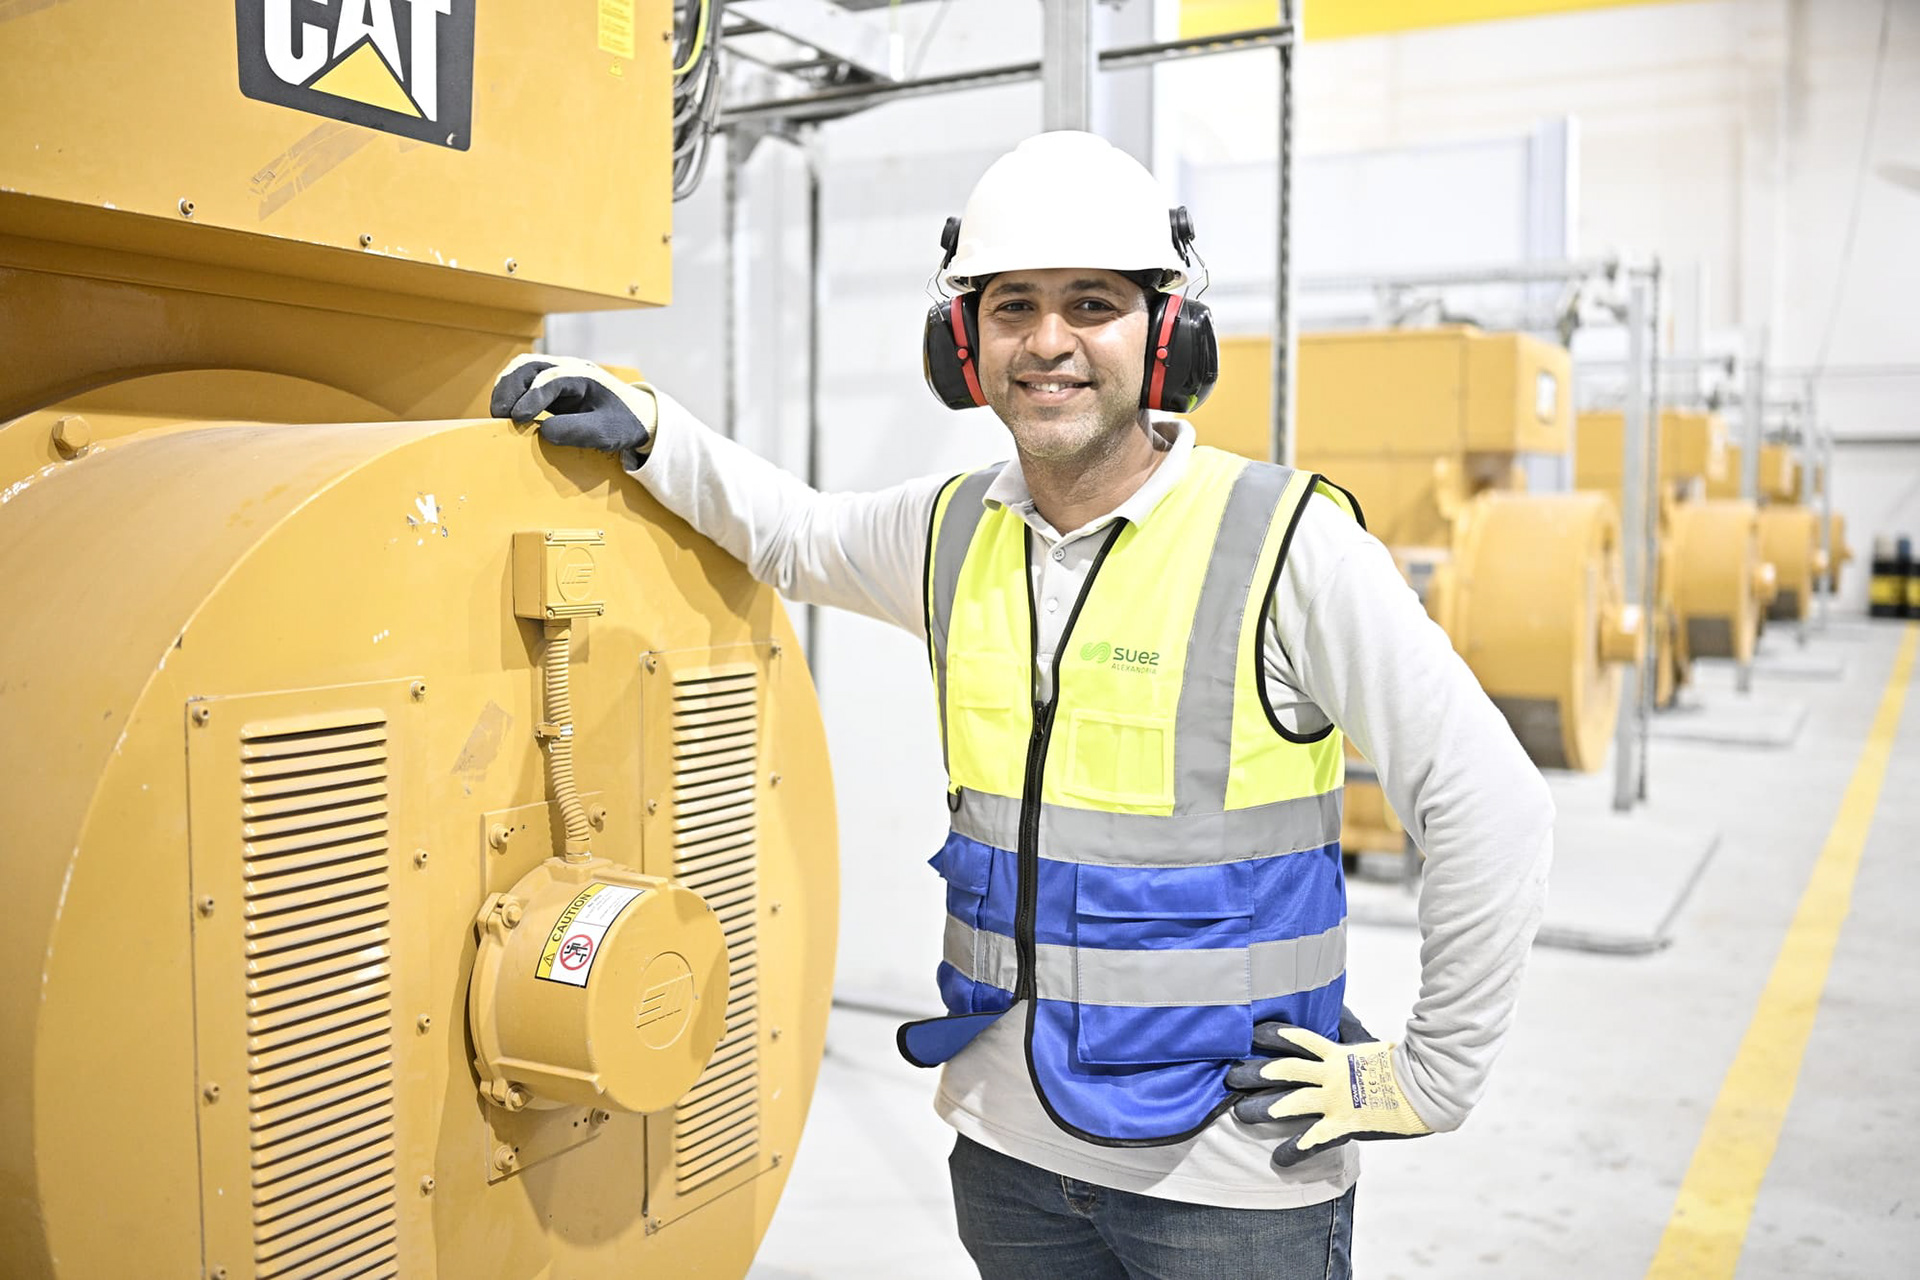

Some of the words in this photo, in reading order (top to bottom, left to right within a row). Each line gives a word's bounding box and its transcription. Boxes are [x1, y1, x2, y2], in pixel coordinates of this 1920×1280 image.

[264, 0, 451, 122] CAT
[1111, 663, 1157, 675] ALEXANDRIA
[552, 893, 592, 942] CAUTION
